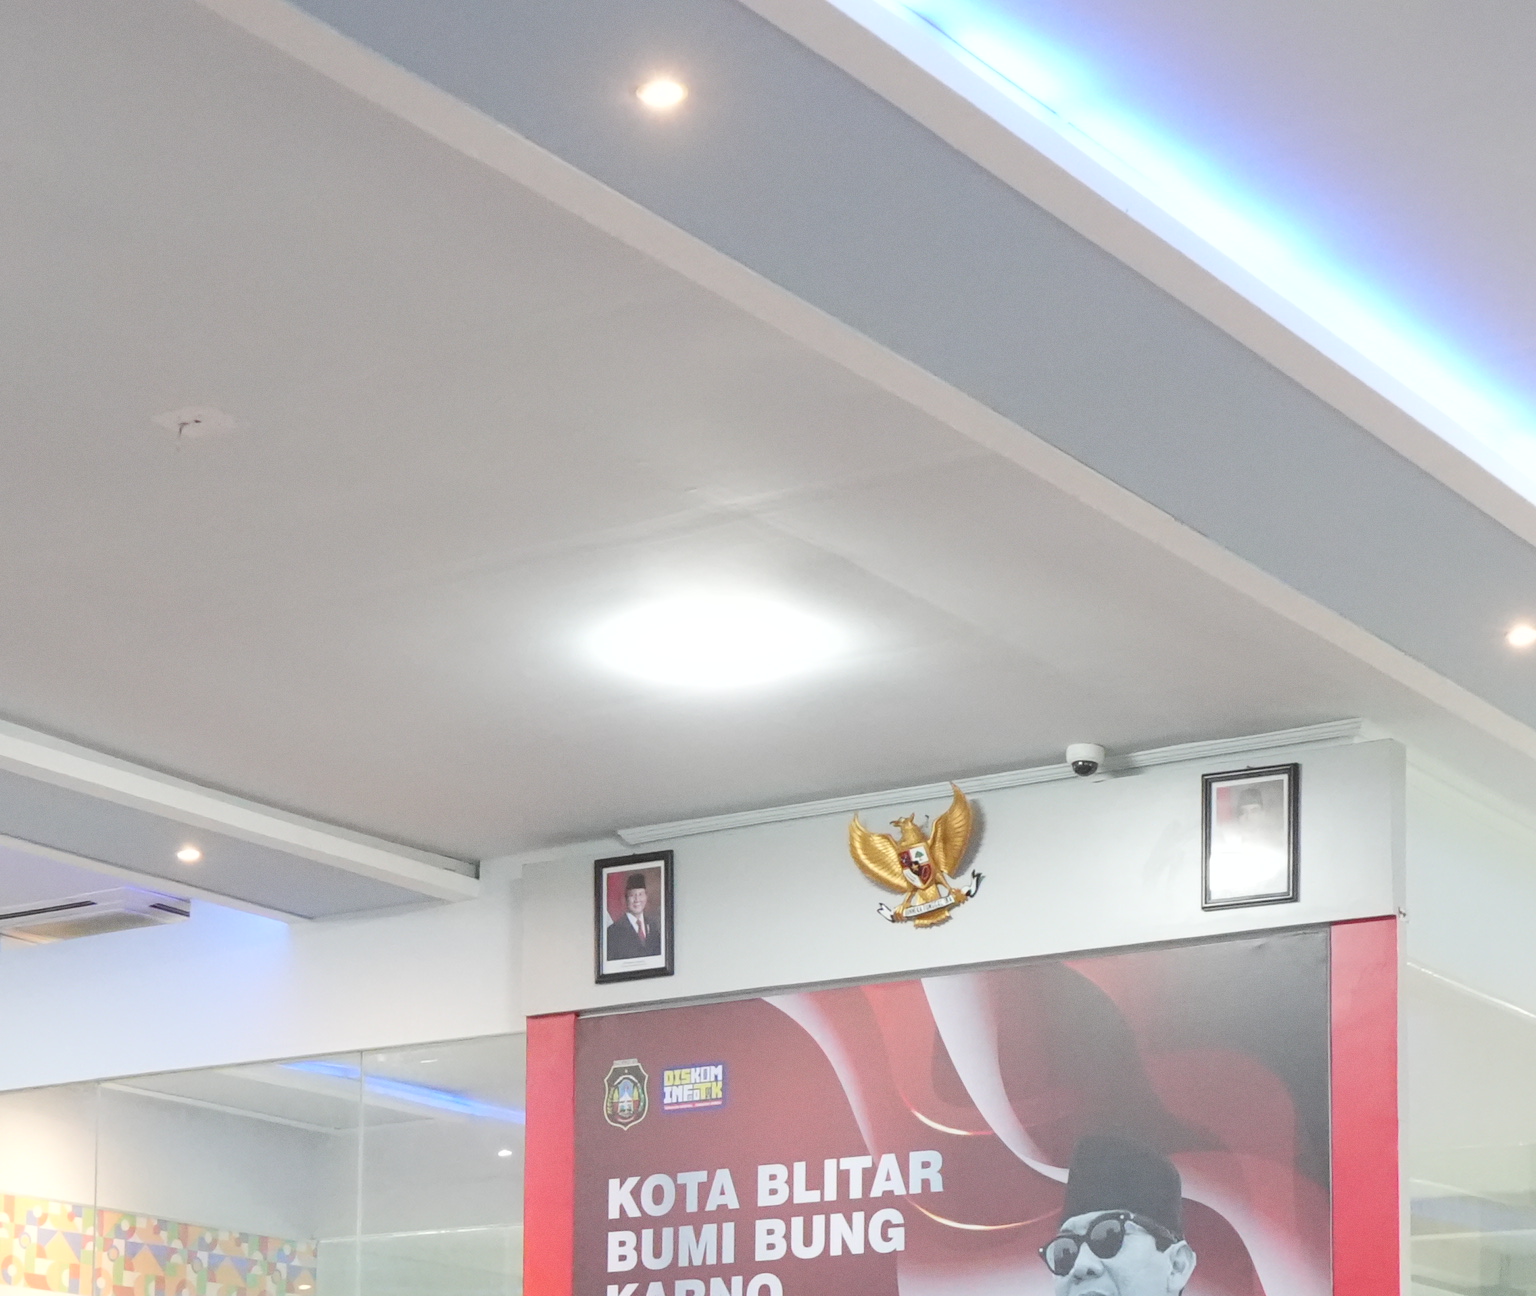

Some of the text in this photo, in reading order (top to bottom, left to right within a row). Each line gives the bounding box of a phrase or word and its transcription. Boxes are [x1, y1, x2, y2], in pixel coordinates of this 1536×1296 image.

[664, 1065, 722, 1086] DISKOM
[608, 1150, 943, 1219] KOTA BLITAR
[607, 1208, 905, 1272] BUMI BUNG
